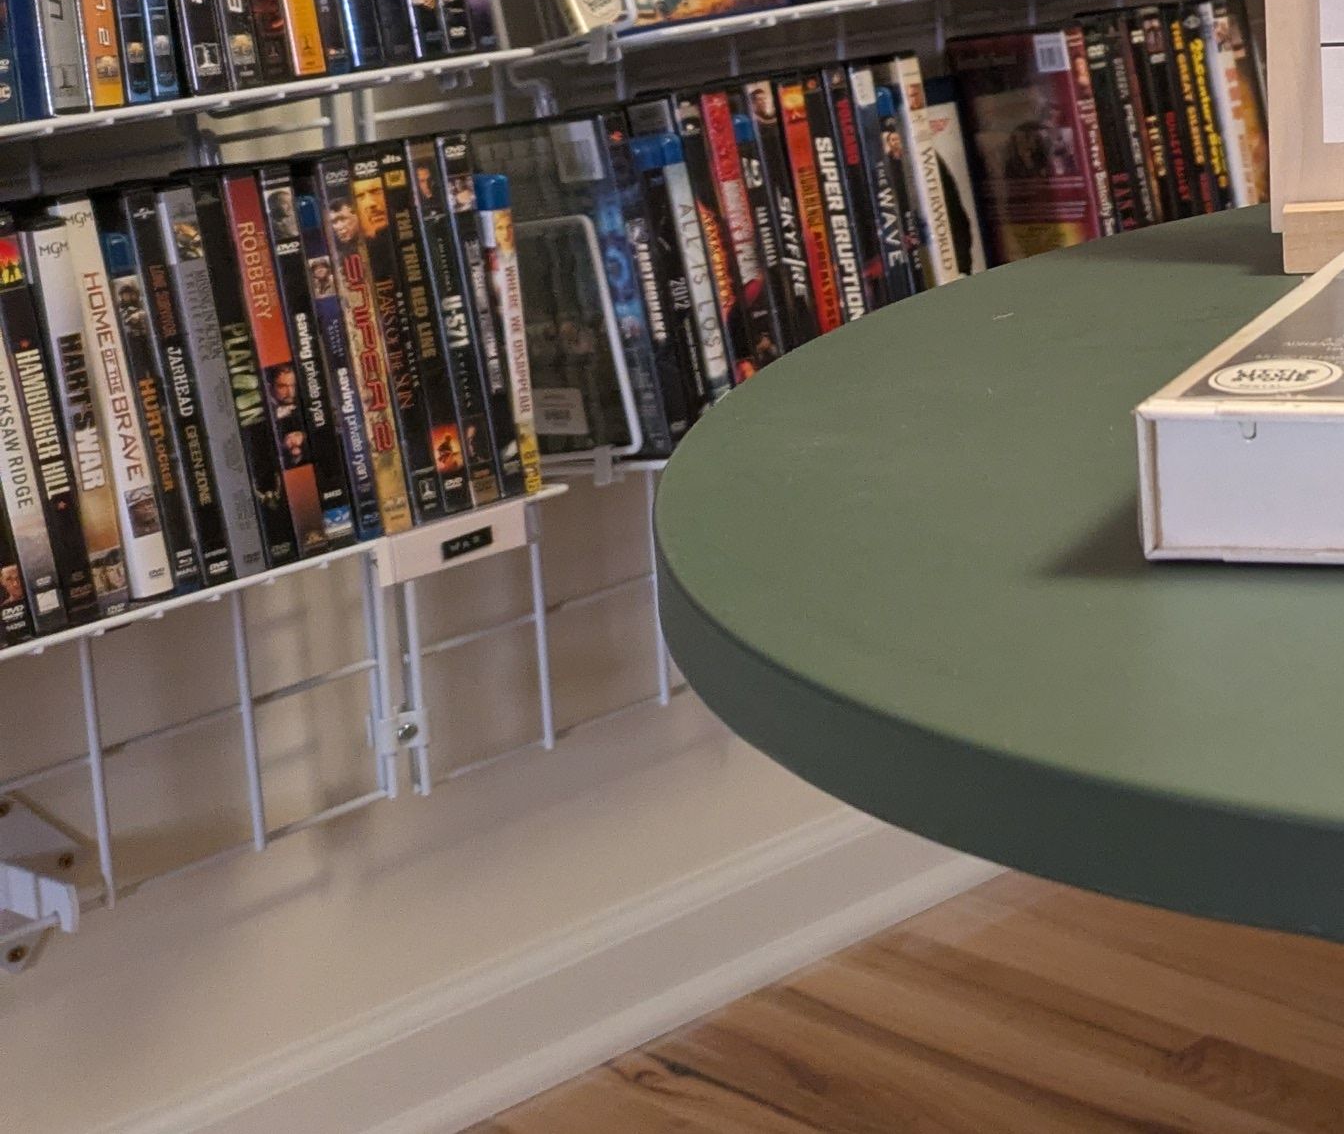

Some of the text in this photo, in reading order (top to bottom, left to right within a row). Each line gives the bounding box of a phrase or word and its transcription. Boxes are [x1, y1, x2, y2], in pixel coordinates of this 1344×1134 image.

[815, 136, 867, 321] SUPER ERUPTION
[877, 187, 906, 266] WAVE
[919, 146, 953, 271] WATERWORLD
[237, 220, 273, 320] ROBBERY
[15, 348, 69, 501] HAMBURGER HILL
[83, 271, 145, 481] HOME BRAVE
[166, 346, 194, 417] JARHEAD
[8, 446, 33, 508] RIDGE
